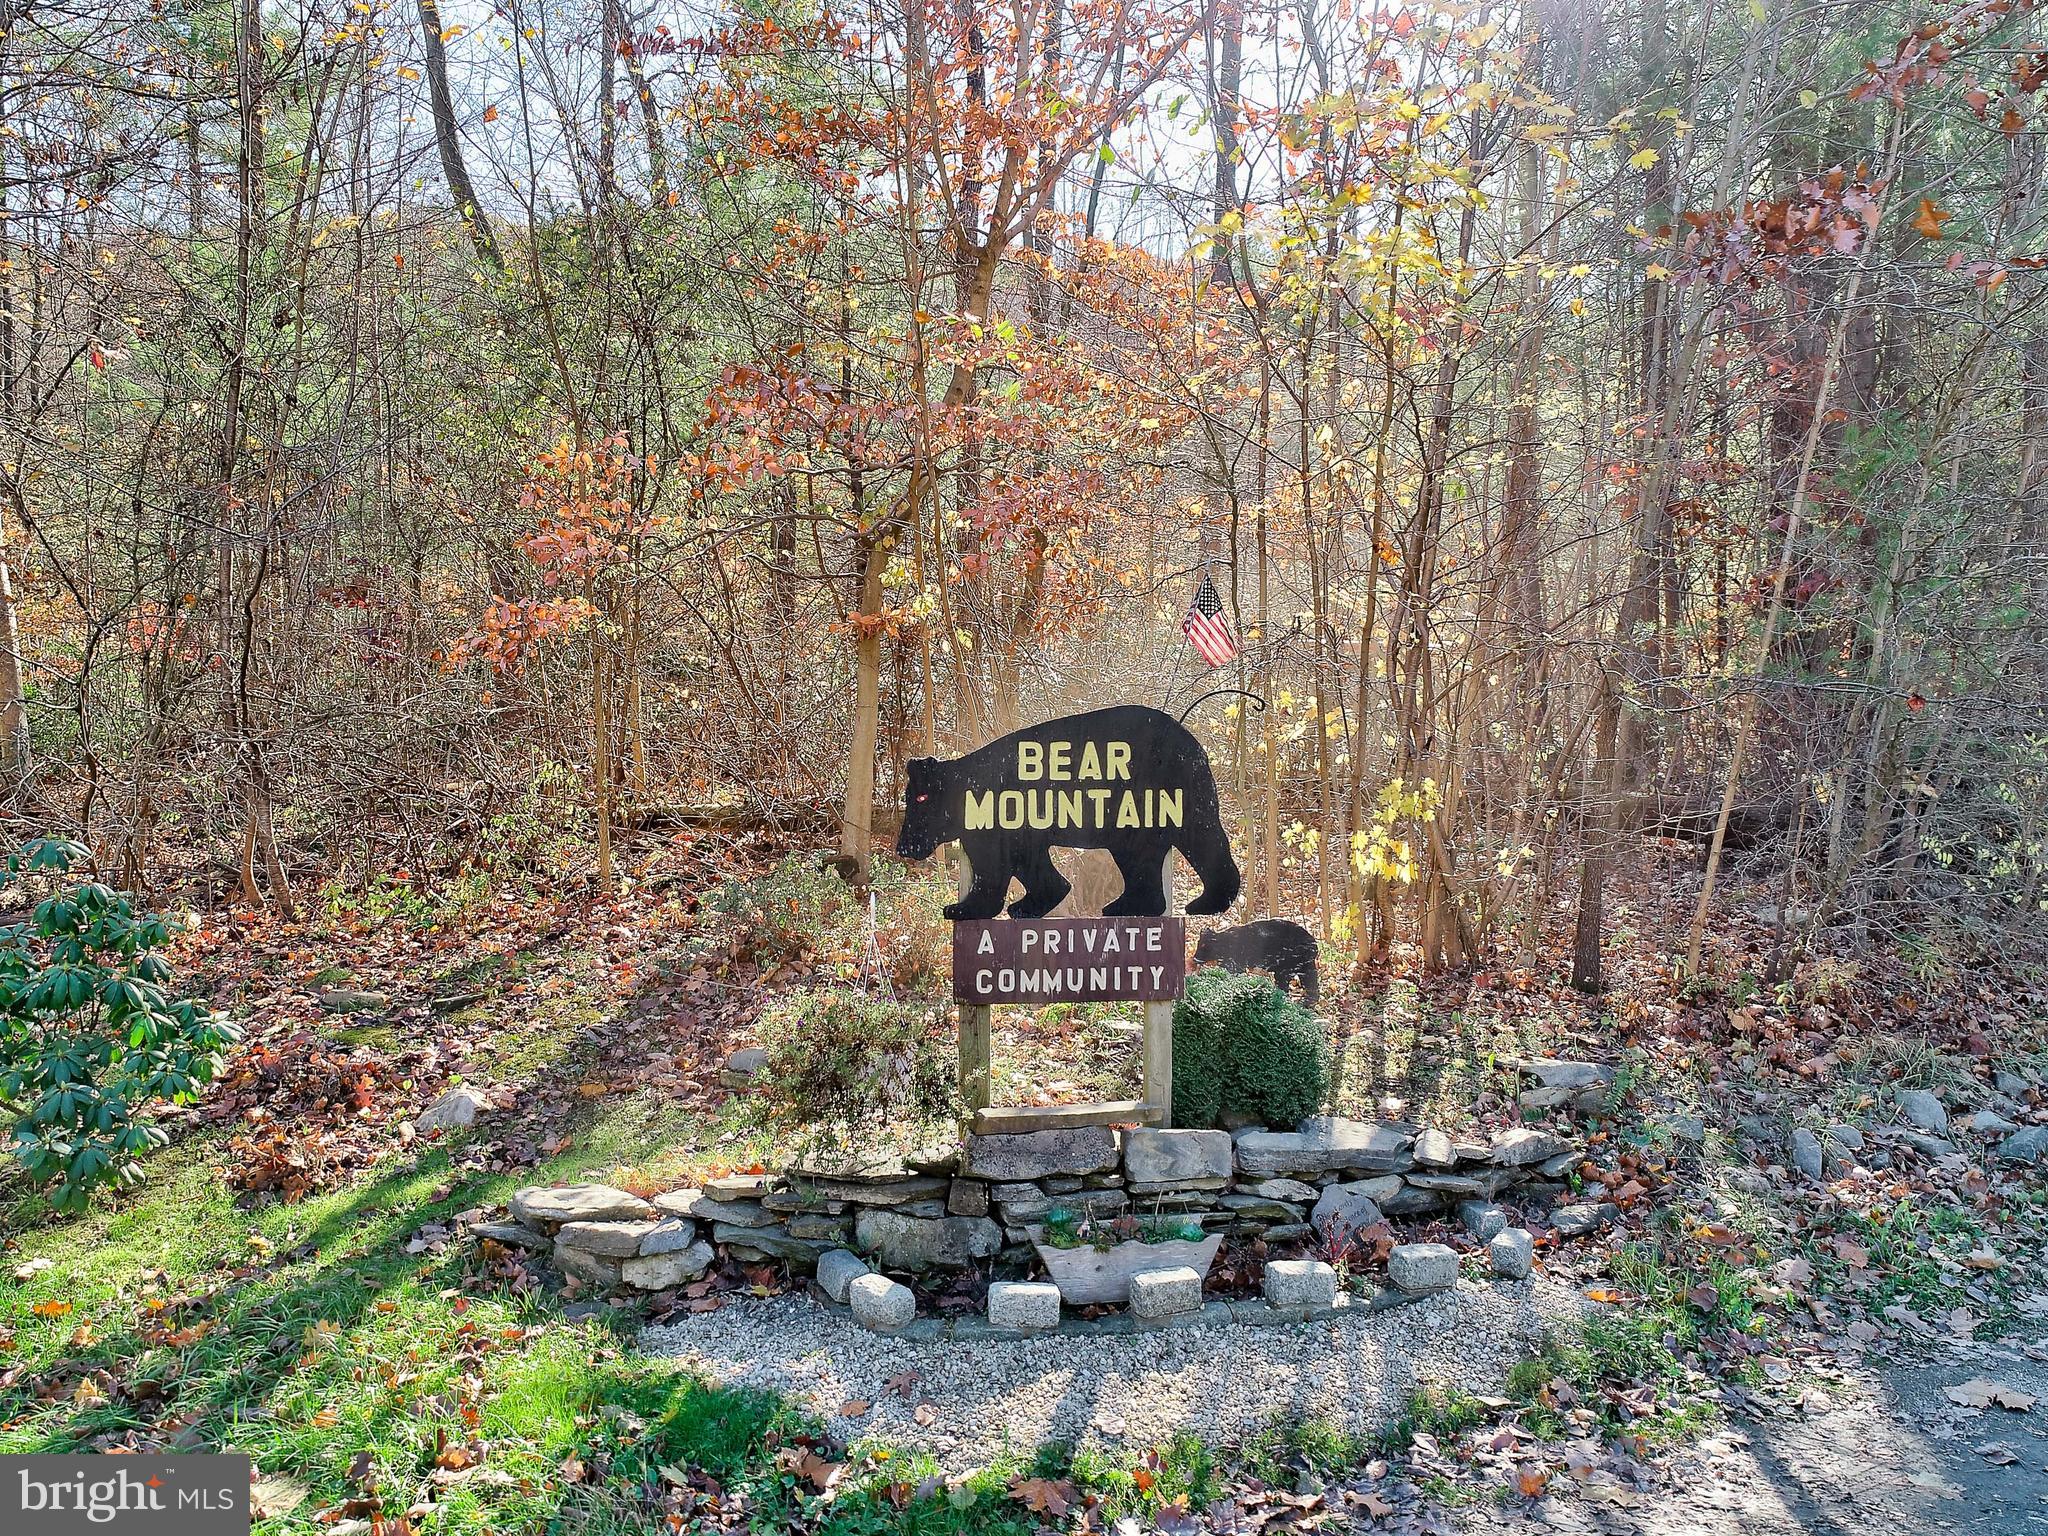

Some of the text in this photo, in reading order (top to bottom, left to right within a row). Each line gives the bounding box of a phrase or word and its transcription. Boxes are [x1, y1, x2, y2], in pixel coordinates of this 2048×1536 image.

[1017, 741, 1132, 781] BEAR
[964, 788, 1184, 830] MOUNTAIN
[977, 926, 1163, 955] A PRIVATE
[975, 965, 1165, 995] COMMUNITY
